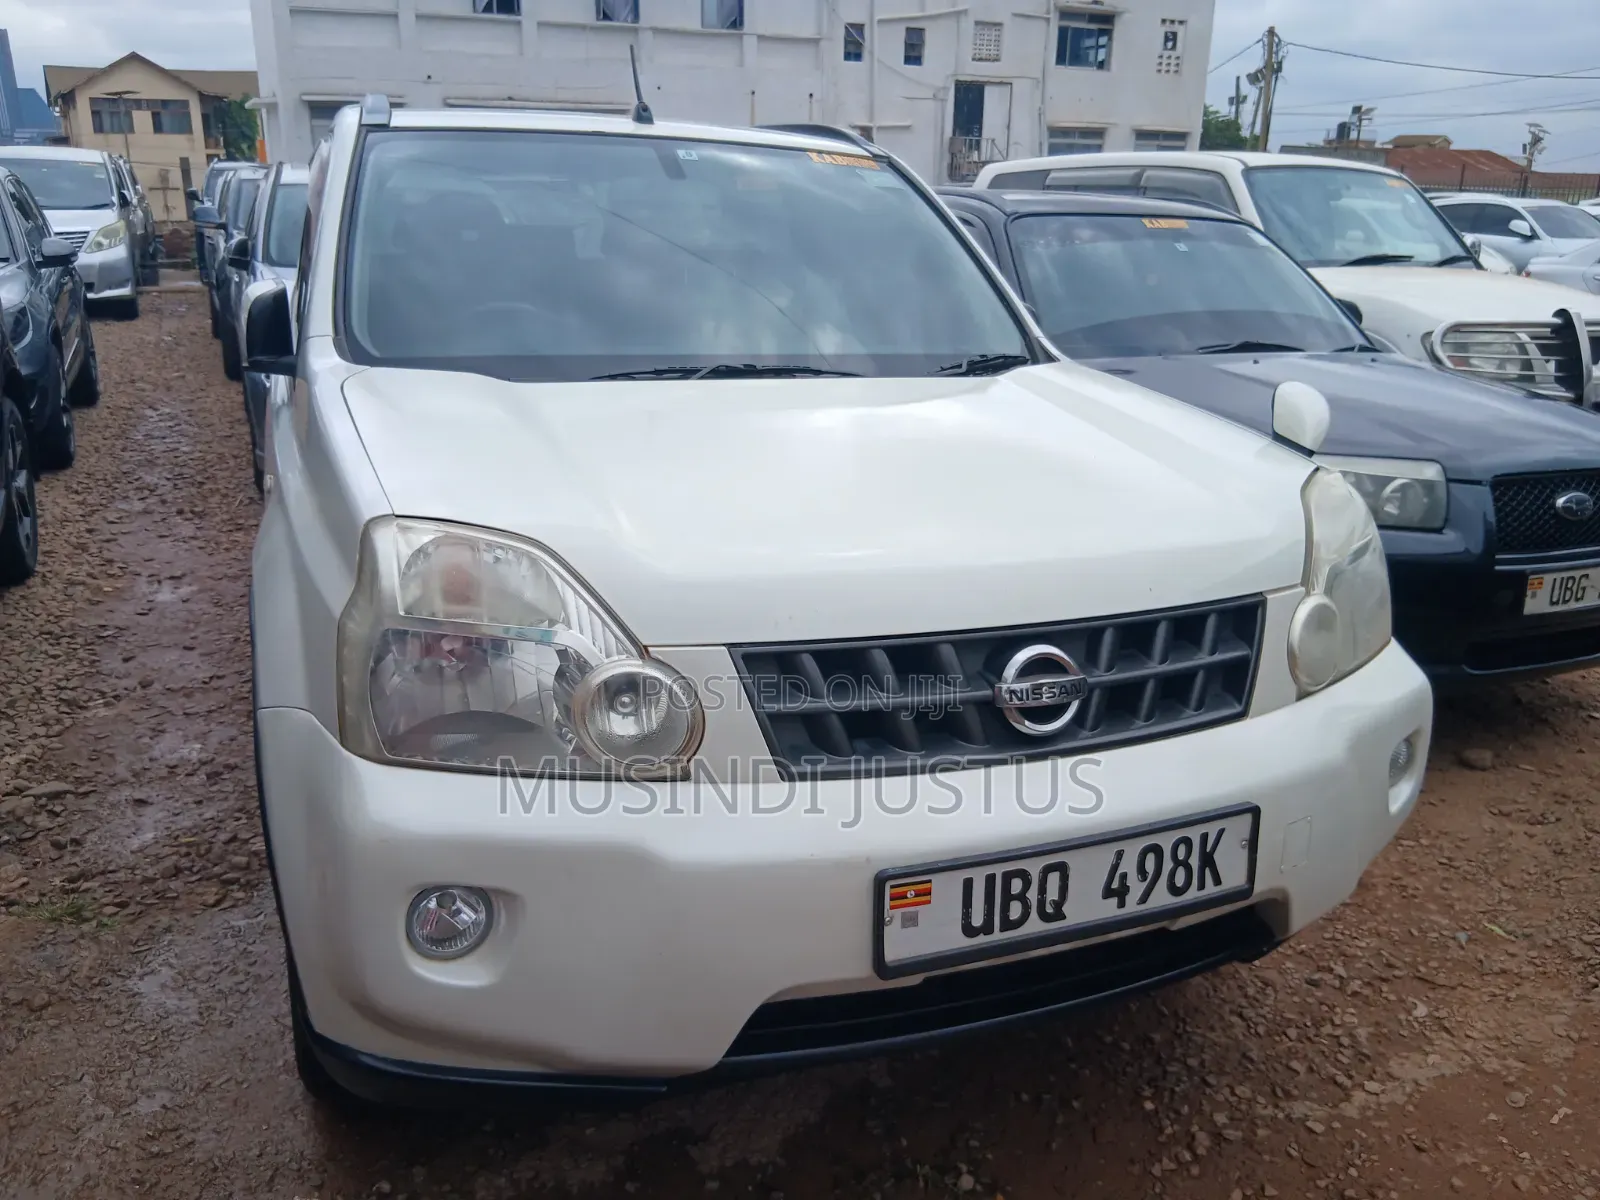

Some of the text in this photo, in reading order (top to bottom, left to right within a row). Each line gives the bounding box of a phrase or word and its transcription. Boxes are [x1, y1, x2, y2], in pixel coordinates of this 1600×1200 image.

[1550, 574, 1589, 606] UBG
[1008, 681, 1081, 702] NISSAN
[961, 827, 1226, 938] UBQ 498K
